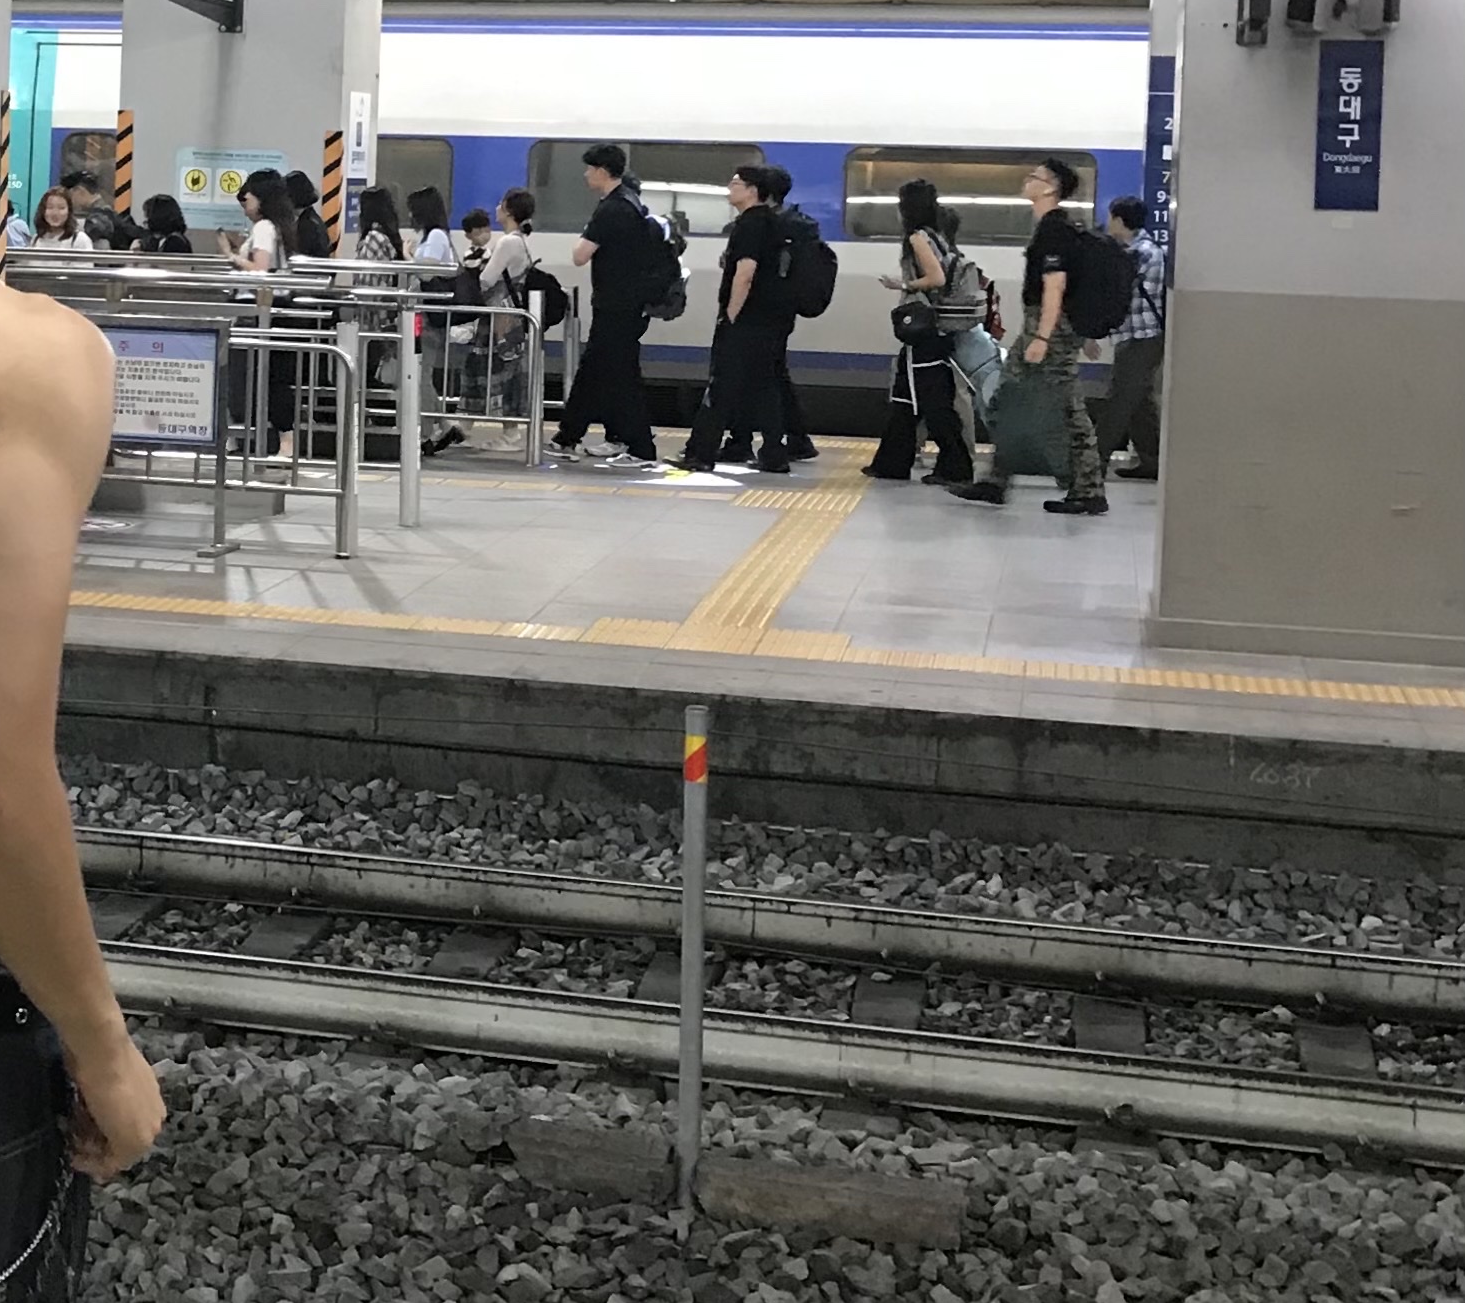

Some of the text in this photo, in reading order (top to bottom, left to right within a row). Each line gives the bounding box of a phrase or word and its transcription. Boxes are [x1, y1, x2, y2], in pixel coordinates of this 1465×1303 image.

[1337, 67, 1362, 148] 동대구
[1162, 171, 1172, 184] 7
[1154, 210, 1168, 223] 11
[1153, 229, 1169, 243] 13
